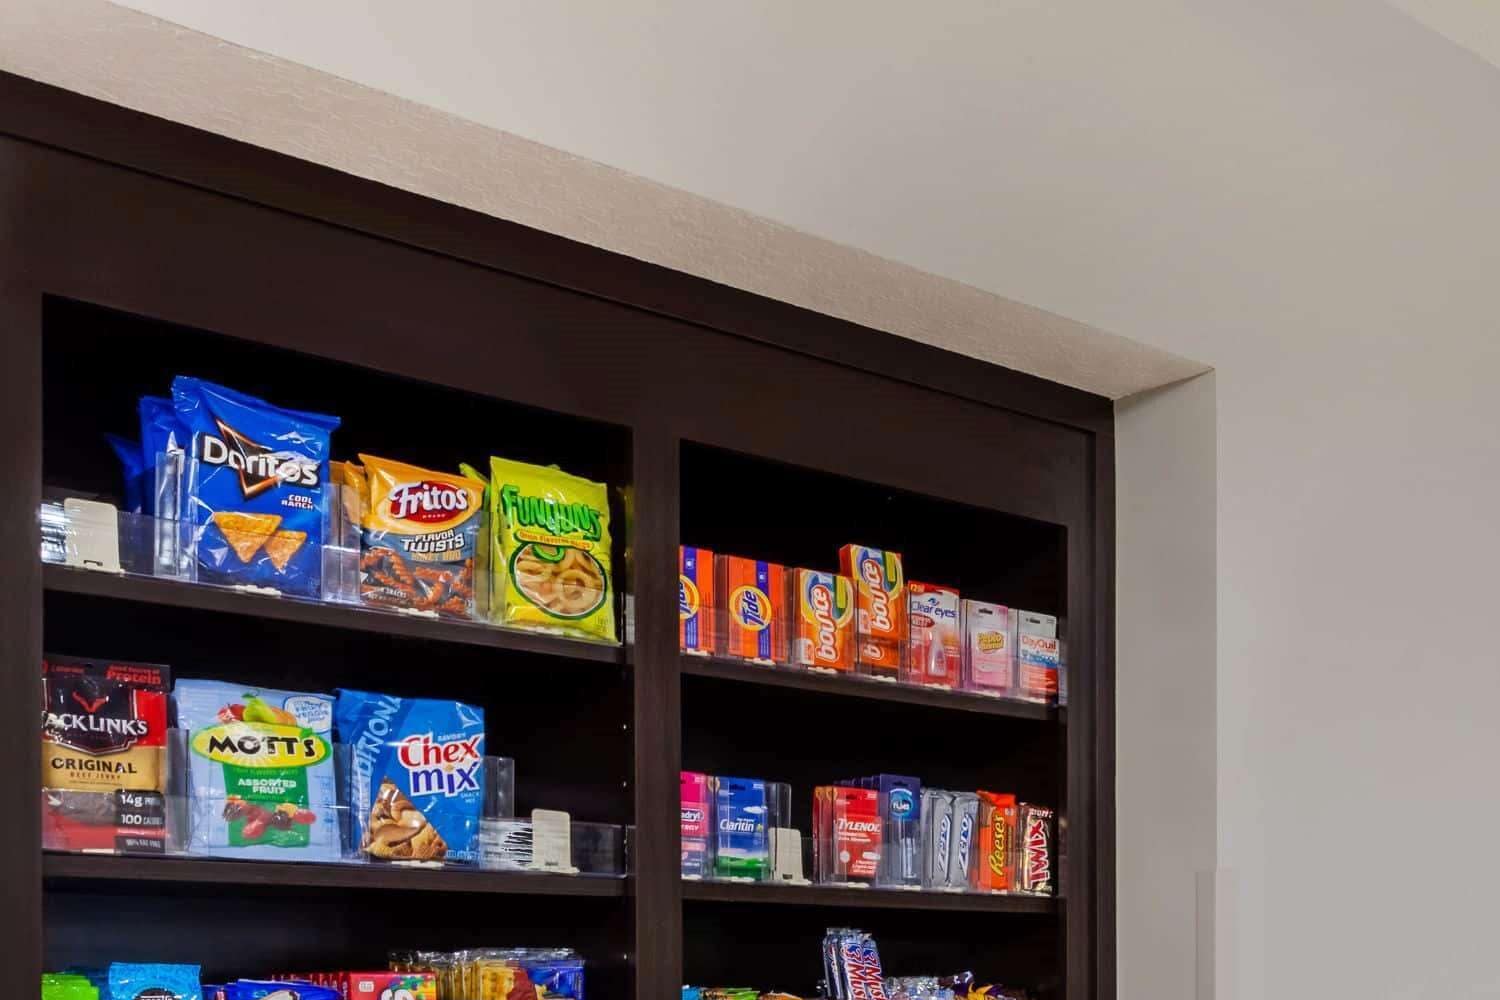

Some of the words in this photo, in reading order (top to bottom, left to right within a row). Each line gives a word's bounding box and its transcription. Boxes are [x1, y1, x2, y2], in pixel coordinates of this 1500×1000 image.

[202, 434, 319, 487] Doritos
[288, 494, 313, 504] COOL
[389, 480, 469, 518] Fritos
[502, 483, 602, 541] FUNYUNS
[400, 533, 466, 553] TWISTS
[415, 529, 455, 543] FLAVOR
[742, 590, 764, 626] Tide
[862, 557, 893, 632] bounce
[815, 585, 840, 662] bounce
[934, 607, 957, 618] eyes
[398, 732, 481, 768] Chex
[51, 756, 138, 775] ORIGINAL
[409, 760, 481, 797] mix
[120, 794, 143, 808] 14g
[120, 813, 143, 826] 100
[719, 818, 754, 833] Claritin
[837, 818, 882, 833] TYLENOL
[1027, 819, 1050, 890] TWIX
